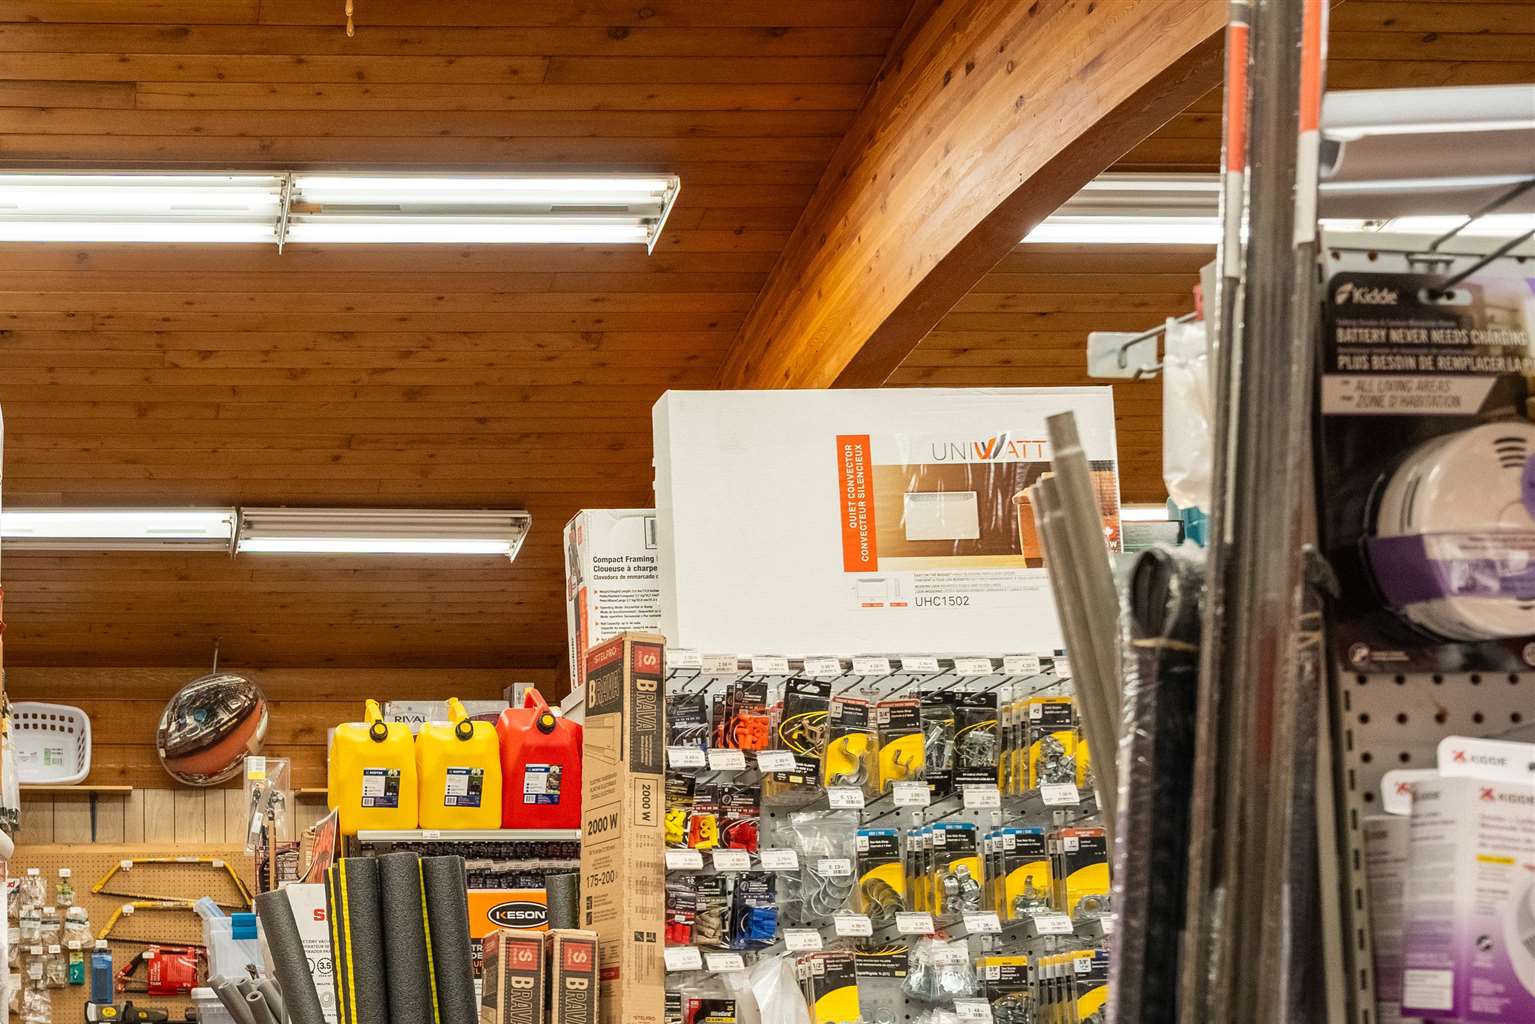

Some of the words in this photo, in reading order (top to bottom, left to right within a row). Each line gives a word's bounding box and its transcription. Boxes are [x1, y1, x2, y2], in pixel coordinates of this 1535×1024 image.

[1351, 286, 1399, 305] Kidde
[1389, 328, 1429, 344] NEVER
[1431, 328, 1469, 344] NEEDS
[1337, 355, 1370, 370] PLUS
[1371, 355, 1417, 371] BESOIN
[1418, 356, 1434, 371] DE
[1437, 356, 1505, 372] REMPLACER
[1355, 395, 1386, 409] ZONE
[931, 434, 1043, 462] UNIWATT
[844, 444, 856, 498] CONVECTOR
[854, 444, 866, 498] SILENCIEUX
[848, 500, 858, 529] QUIET
[857, 500, 870, 562] CONVECTEUR
[592, 556, 624, 564] Compact
[625, 555, 655, 564] Framing
[593, 565, 625, 573] Cloueuse
[915, 596, 970, 607] UHC1502
[636, 679, 658, 732] BRAVA
[394, 715, 428, 723] RIVAL
[642, 783, 651, 811] 2000
[587, 816, 609, 836] 2000
[610, 812, 619, 830] W
[642, 814, 651, 822] W
[496, 910, 546, 920] KESON
[319, 962, 332, 970] 3.5
